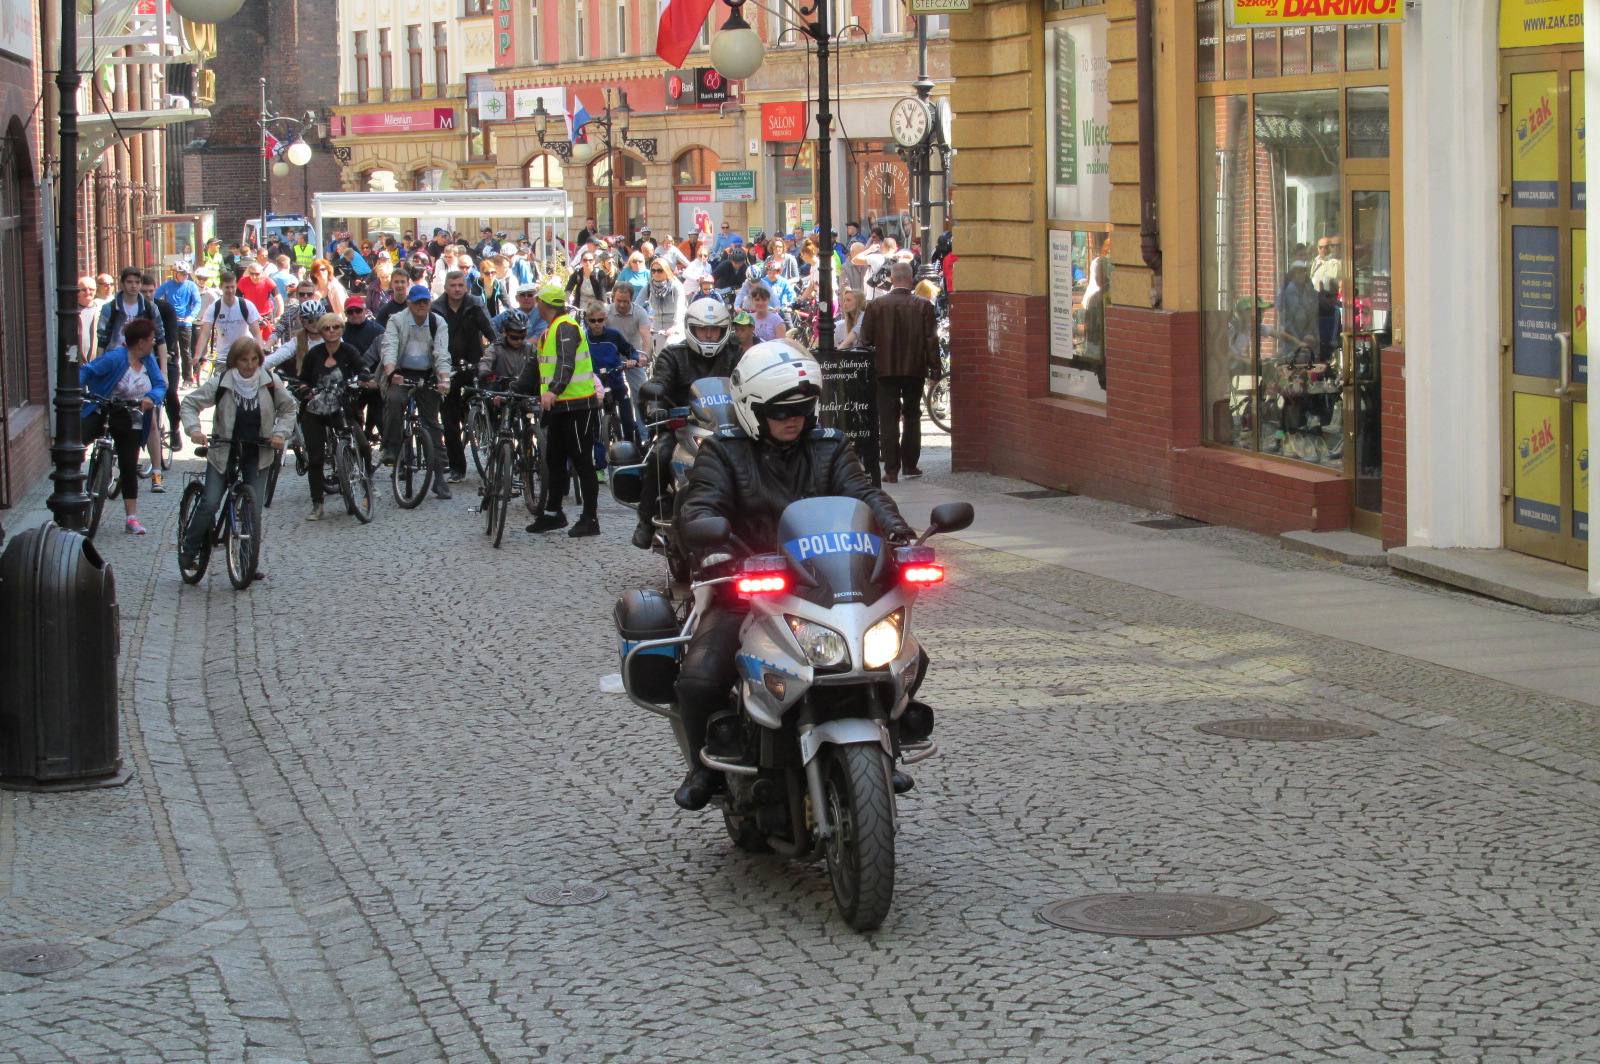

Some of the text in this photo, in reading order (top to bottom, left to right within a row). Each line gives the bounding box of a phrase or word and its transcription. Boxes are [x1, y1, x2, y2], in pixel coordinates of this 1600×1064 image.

[915, 0, 967, 9] STEFCZYKA
[1282, 0, 1397, 18] DARMO!
[1265, 9, 1279, 17] za
[384, 113, 413, 125] Millennium
[769, 114, 796, 130] SALON
[875, 177, 897, 199] Styl
[700, 393, 735, 408] POLIC
[798, 532, 875, 559] POLICJA
